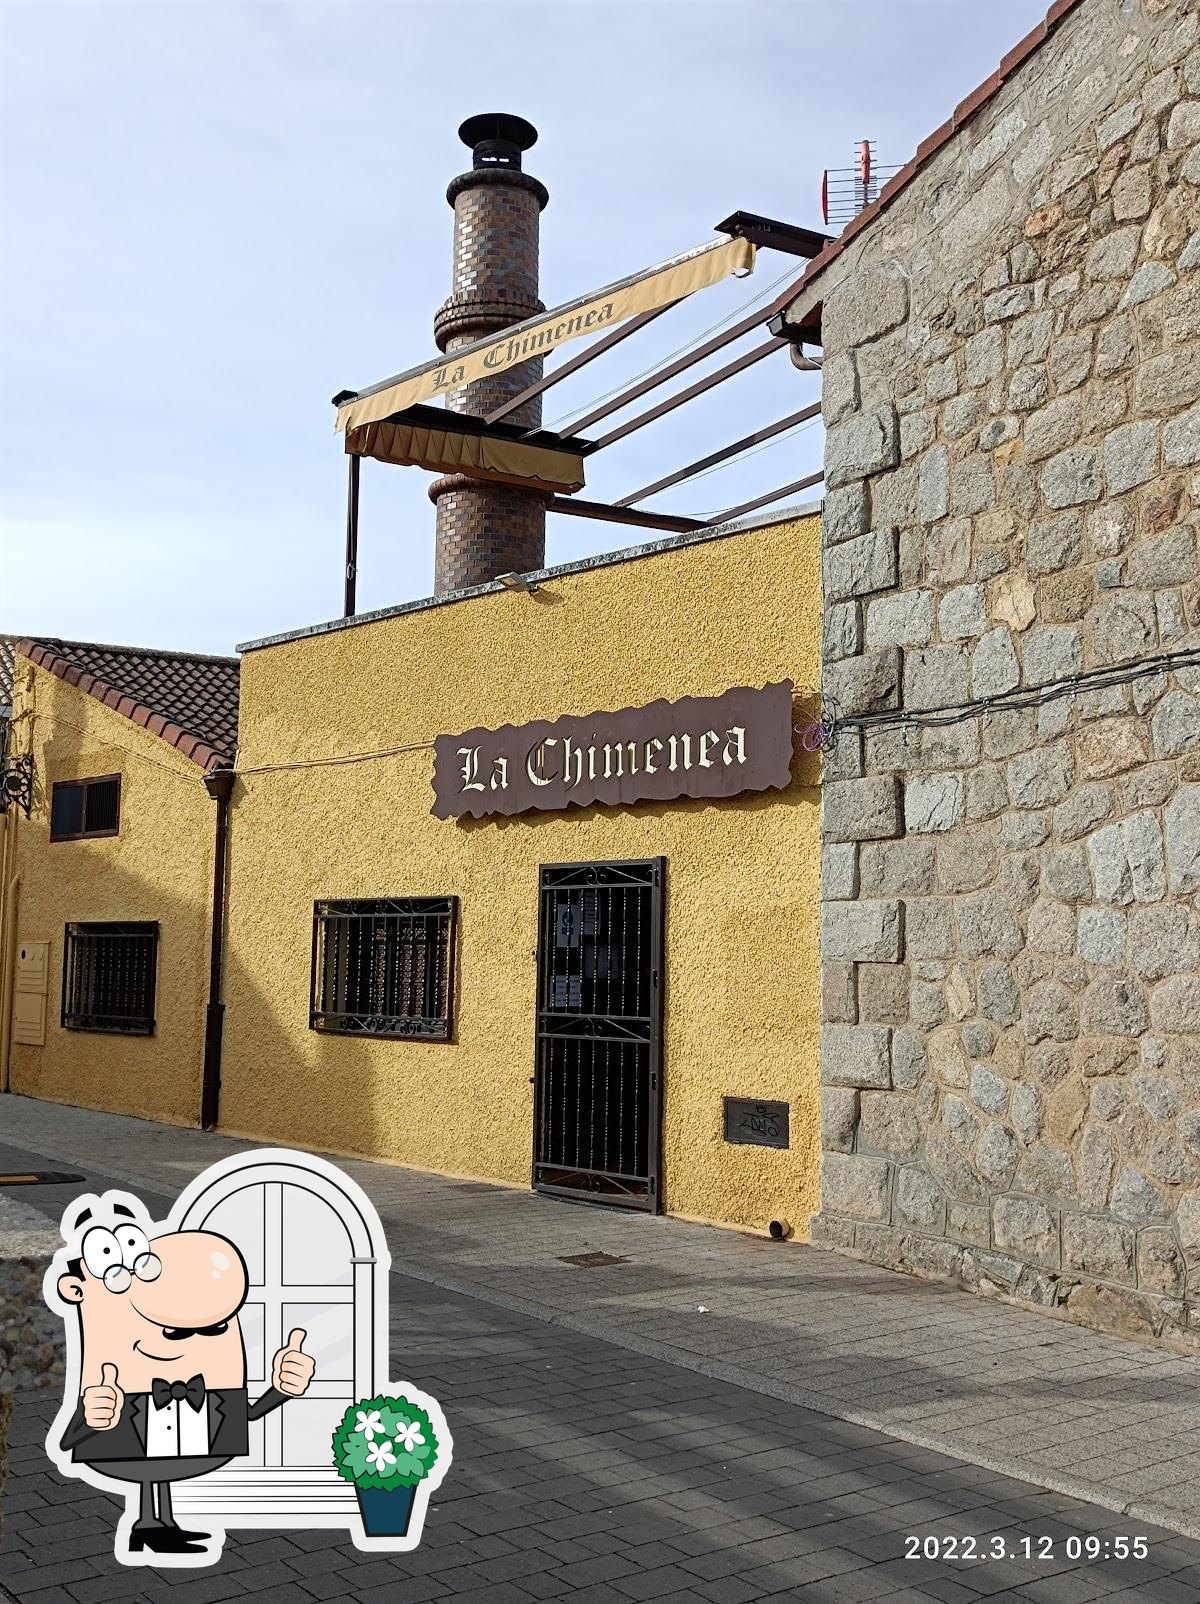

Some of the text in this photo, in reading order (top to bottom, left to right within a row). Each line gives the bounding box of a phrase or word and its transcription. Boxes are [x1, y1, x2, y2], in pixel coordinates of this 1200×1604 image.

[433, 303, 614, 390] La Chimenea
[455, 726, 748, 793] La Chimenea
